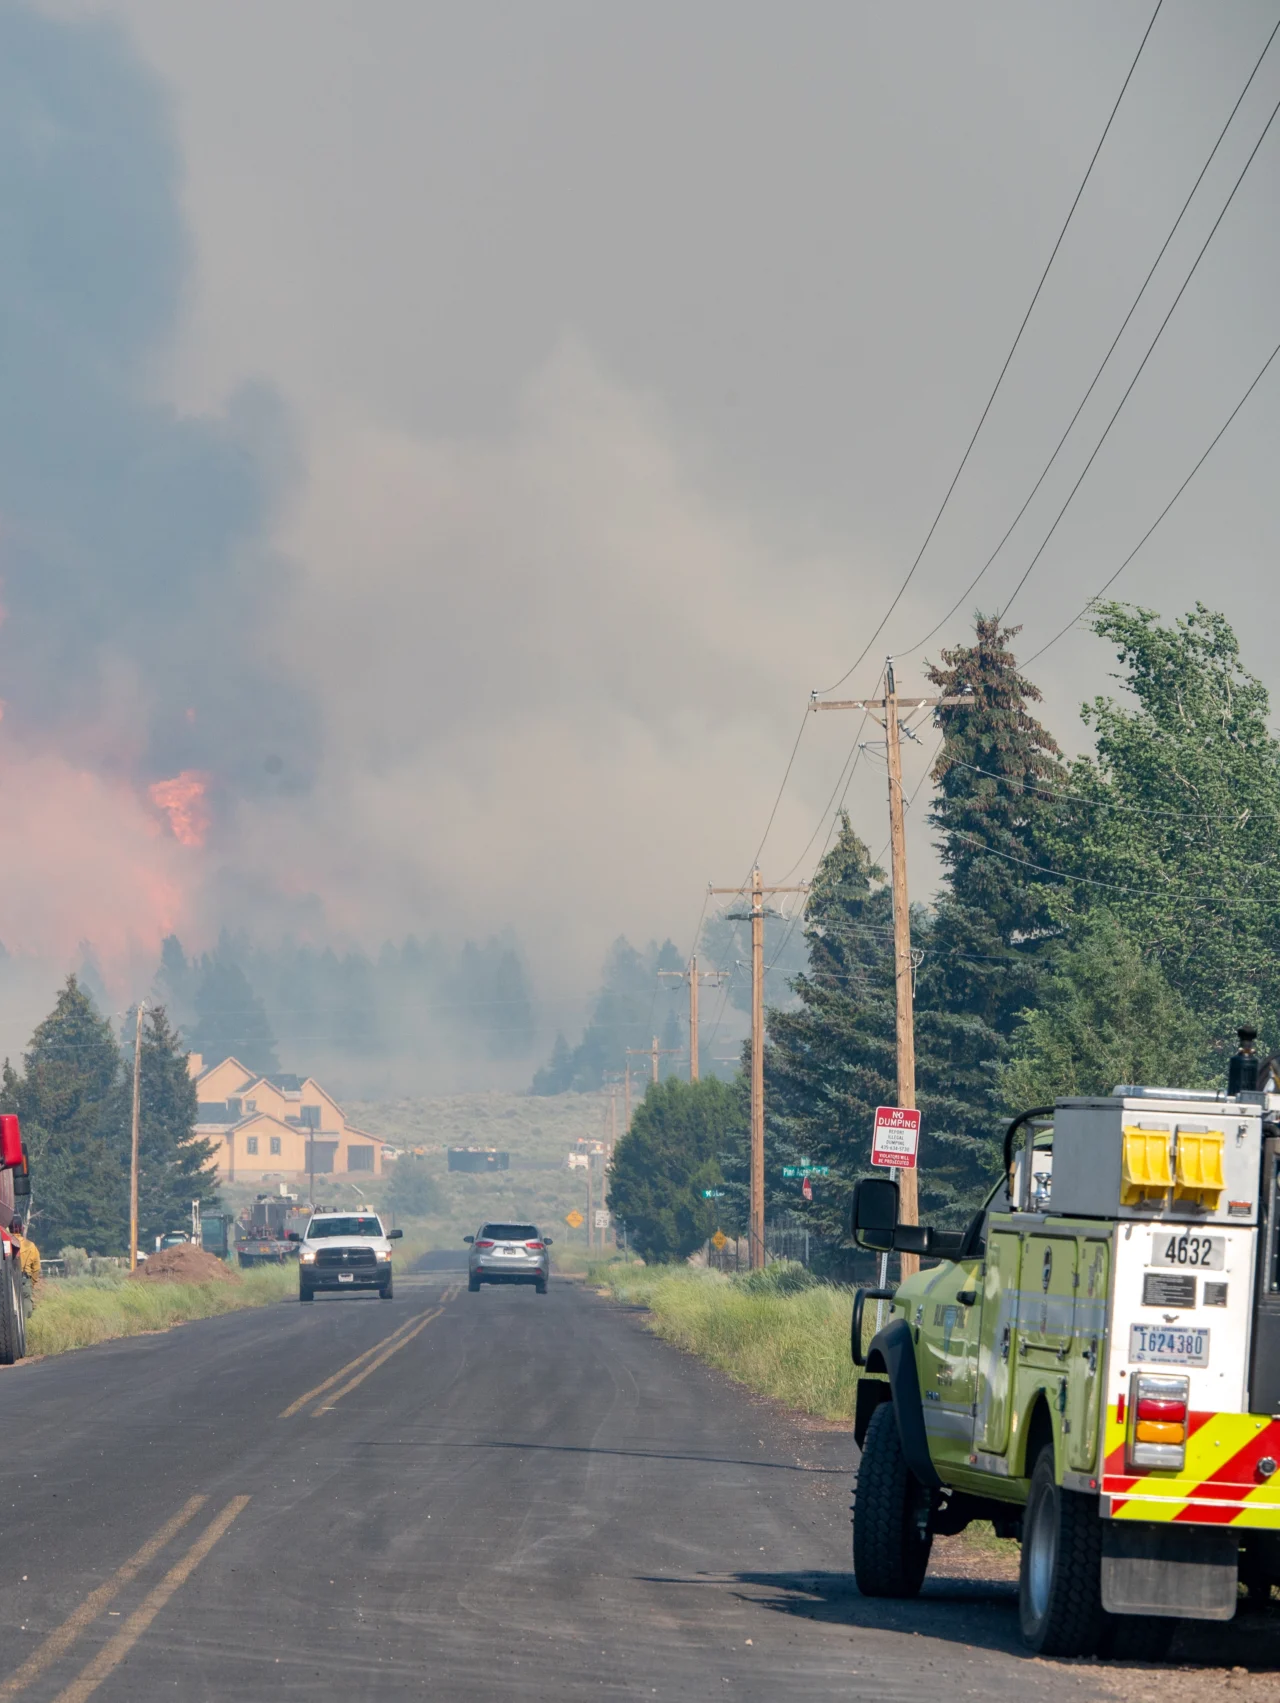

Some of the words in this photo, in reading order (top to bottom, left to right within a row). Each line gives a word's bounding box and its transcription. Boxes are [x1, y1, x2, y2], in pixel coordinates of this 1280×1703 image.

[892, 1111, 904, 1119] NO
[878, 1117, 917, 1128] DUMPING
[596, 1219, 608, 1227] 25
[1165, 1236, 1212, 1266] 4632
[1139, 1332, 1203, 1355] I624380
